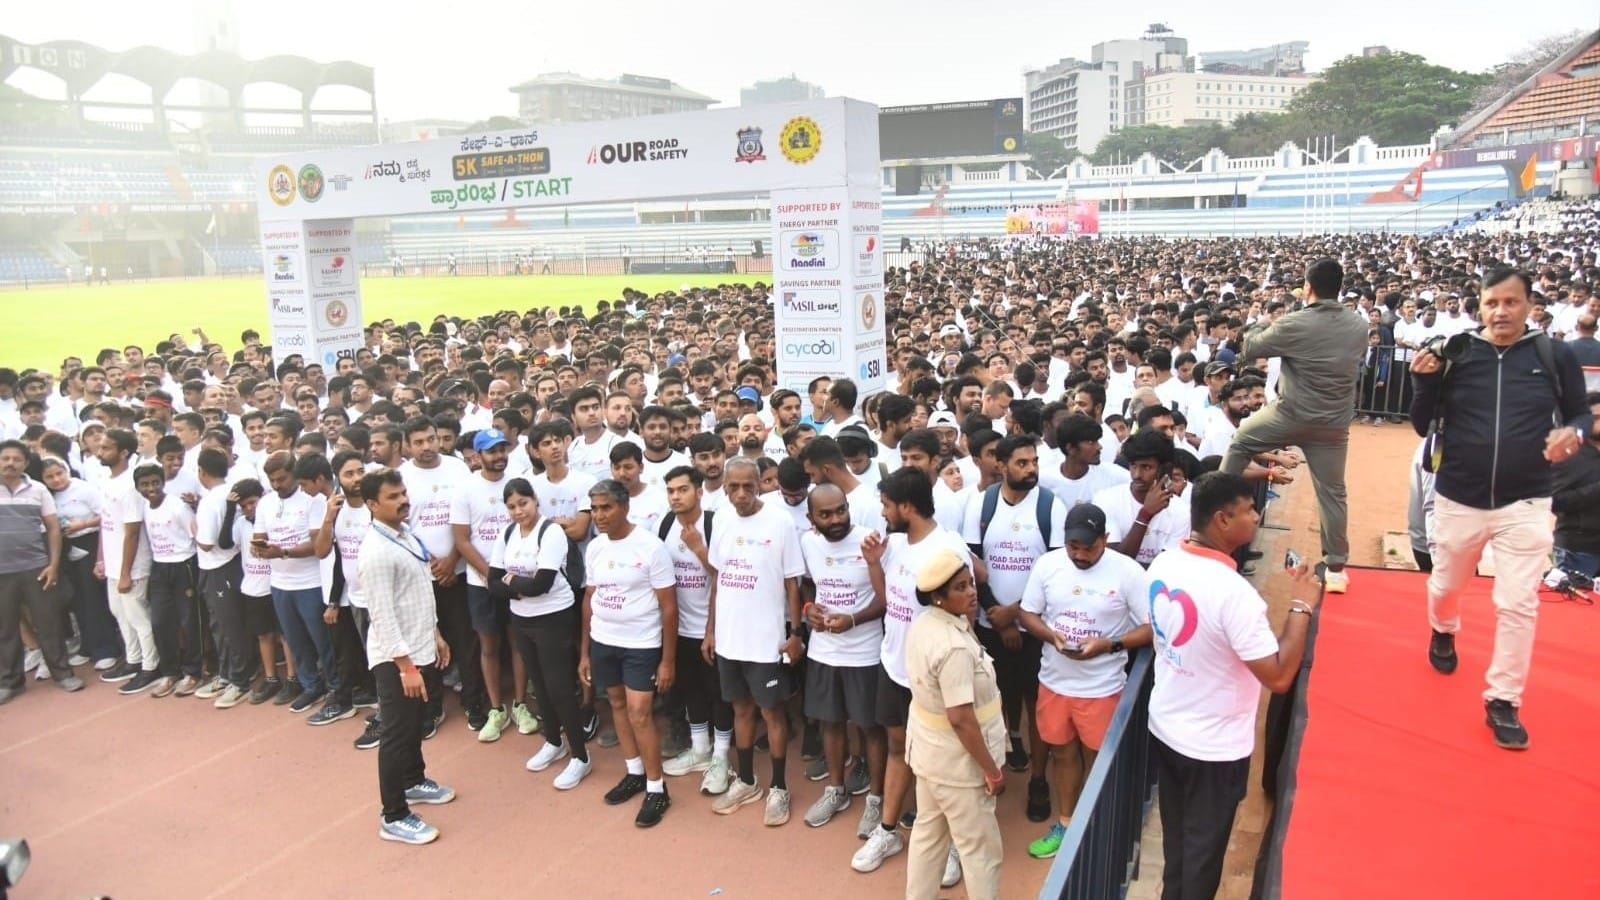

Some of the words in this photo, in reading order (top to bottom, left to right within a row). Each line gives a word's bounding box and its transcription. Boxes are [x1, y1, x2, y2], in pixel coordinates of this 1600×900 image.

[649, 138, 679, 149] ROAD
[600, 141, 647, 165] OUR
[650, 148, 688, 161] SAFETY
[1508, 149, 1517, 160] FC
[456, 158, 478, 177] 5K
[513, 177, 573, 198] START
[777, 203, 827, 213] SUPPORTED
[830, 202, 841, 211] BY
[780, 220, 805, 228] ENERGY
[808, 219, 838, 227] PARTNER
[308, 230, 342, 238] SUPPORTED
[791, 257, 826, 268] Nandini
[780, 280, 808, 288] SAVINGS
[810, 279, 841, 287] PARTNER
[791, 301, 816, 312] MSIL
[868, 359, 880, 379] SBI
[989, 555, 1007, 563] ROAD
[991, 563, 1030, 572] CHAMPION
[734, 574, 758, 583] SAFETY
